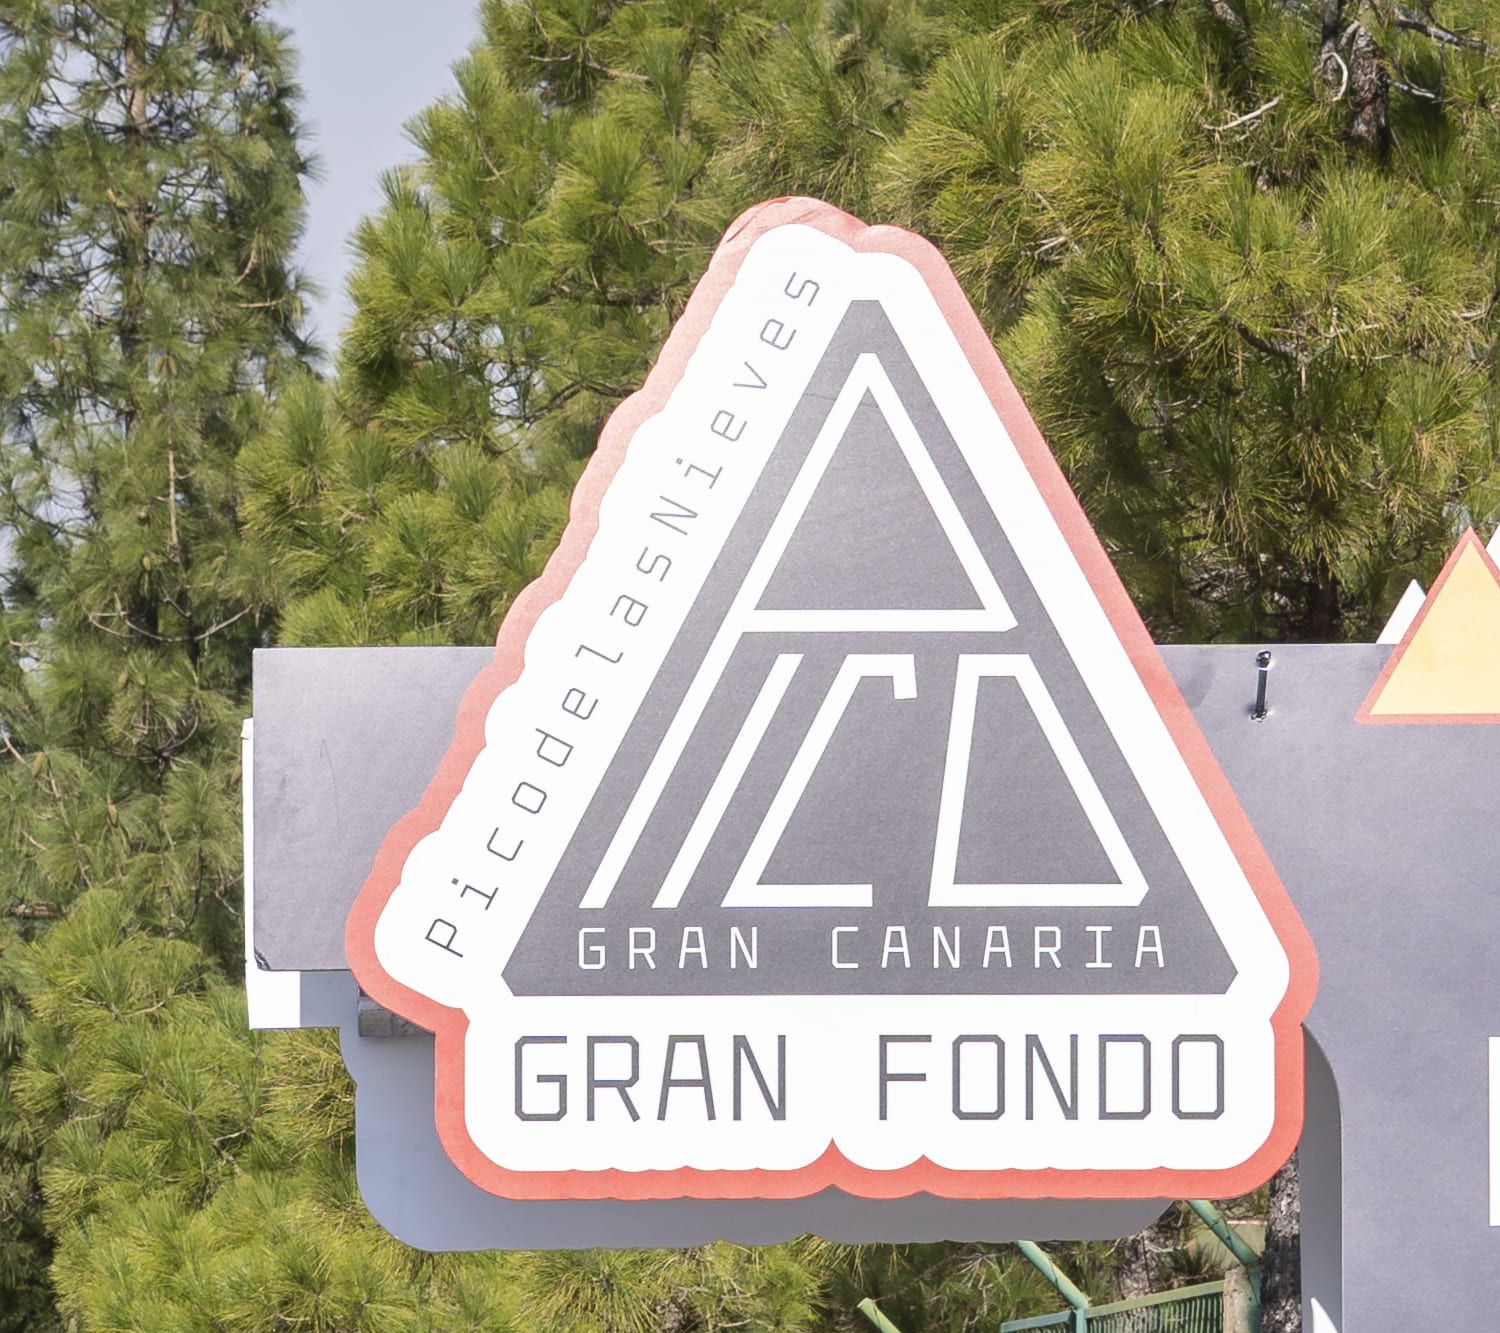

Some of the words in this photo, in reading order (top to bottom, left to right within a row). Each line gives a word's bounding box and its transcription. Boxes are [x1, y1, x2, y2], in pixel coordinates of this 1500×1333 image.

[577, 926, 760, 971] GRAN
[831, 924, 1167, 970] CANARIA
[513, 1035, 789, 1123] GRAN
[878, 1033, 1226, 1122] FONDO
